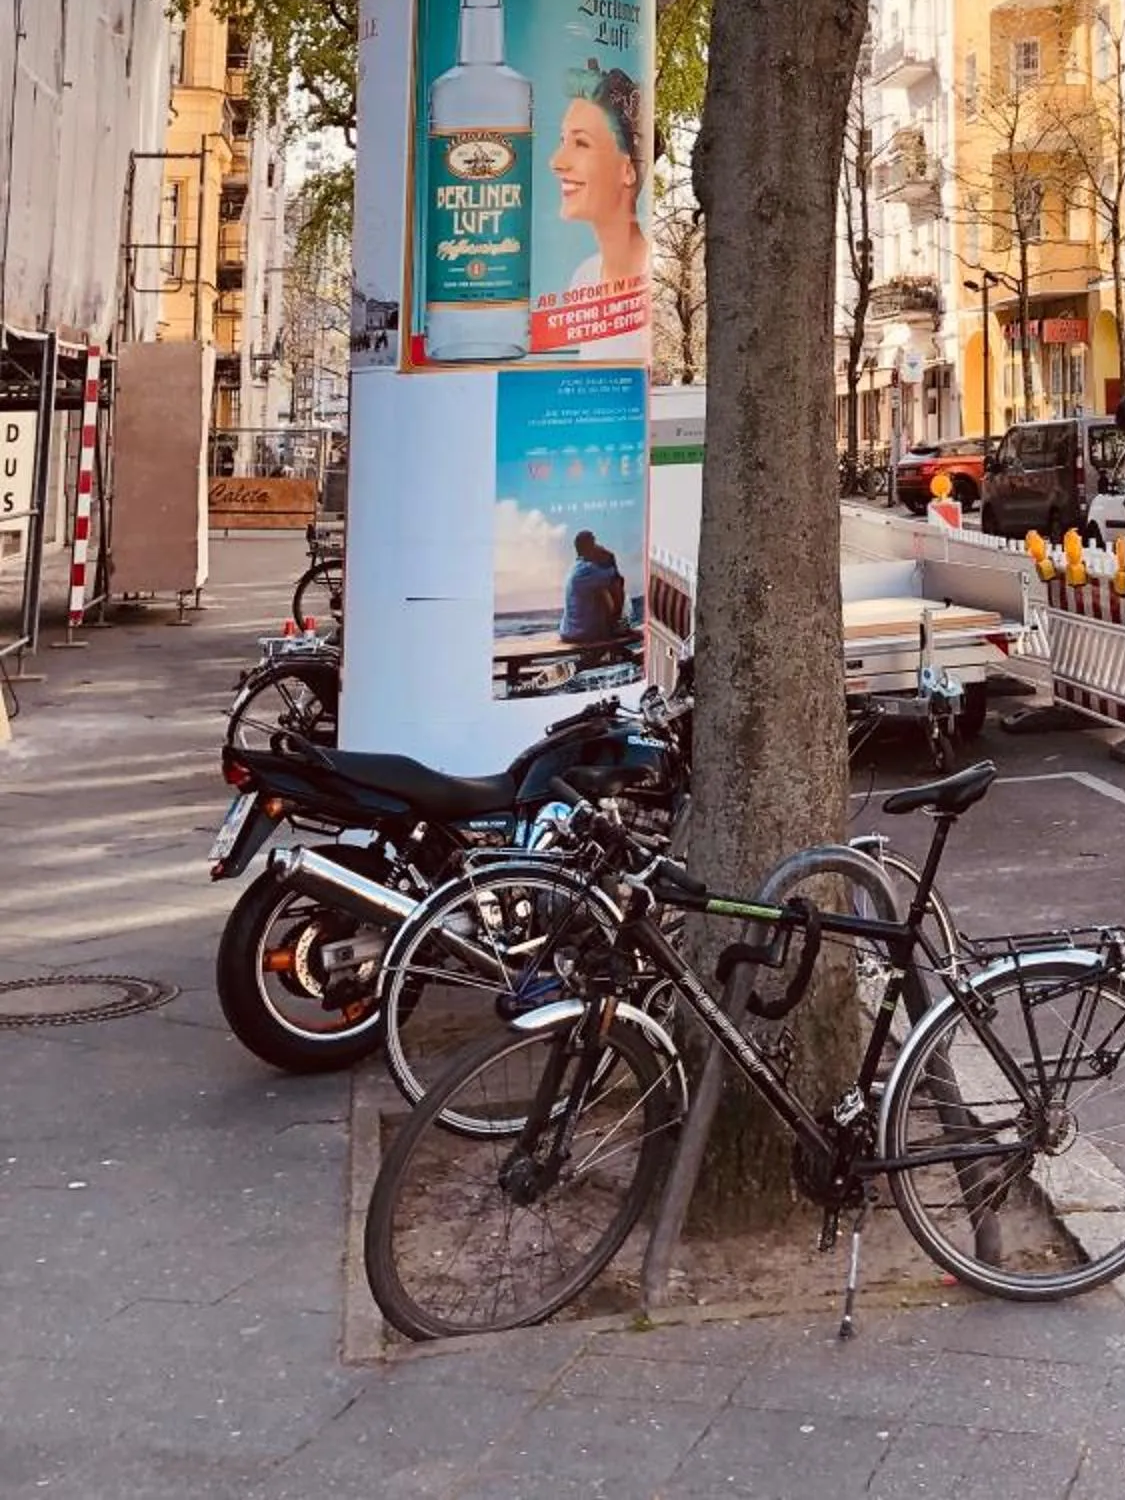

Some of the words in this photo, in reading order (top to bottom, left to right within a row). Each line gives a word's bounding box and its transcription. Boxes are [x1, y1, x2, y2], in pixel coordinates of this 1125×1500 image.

[593, 20, 630, 53] Luft
[436, 183, 522, 210] BERLINER
[453, 210, 502, 235] LUFT
[562, 283, 609, 304] SOFORT
